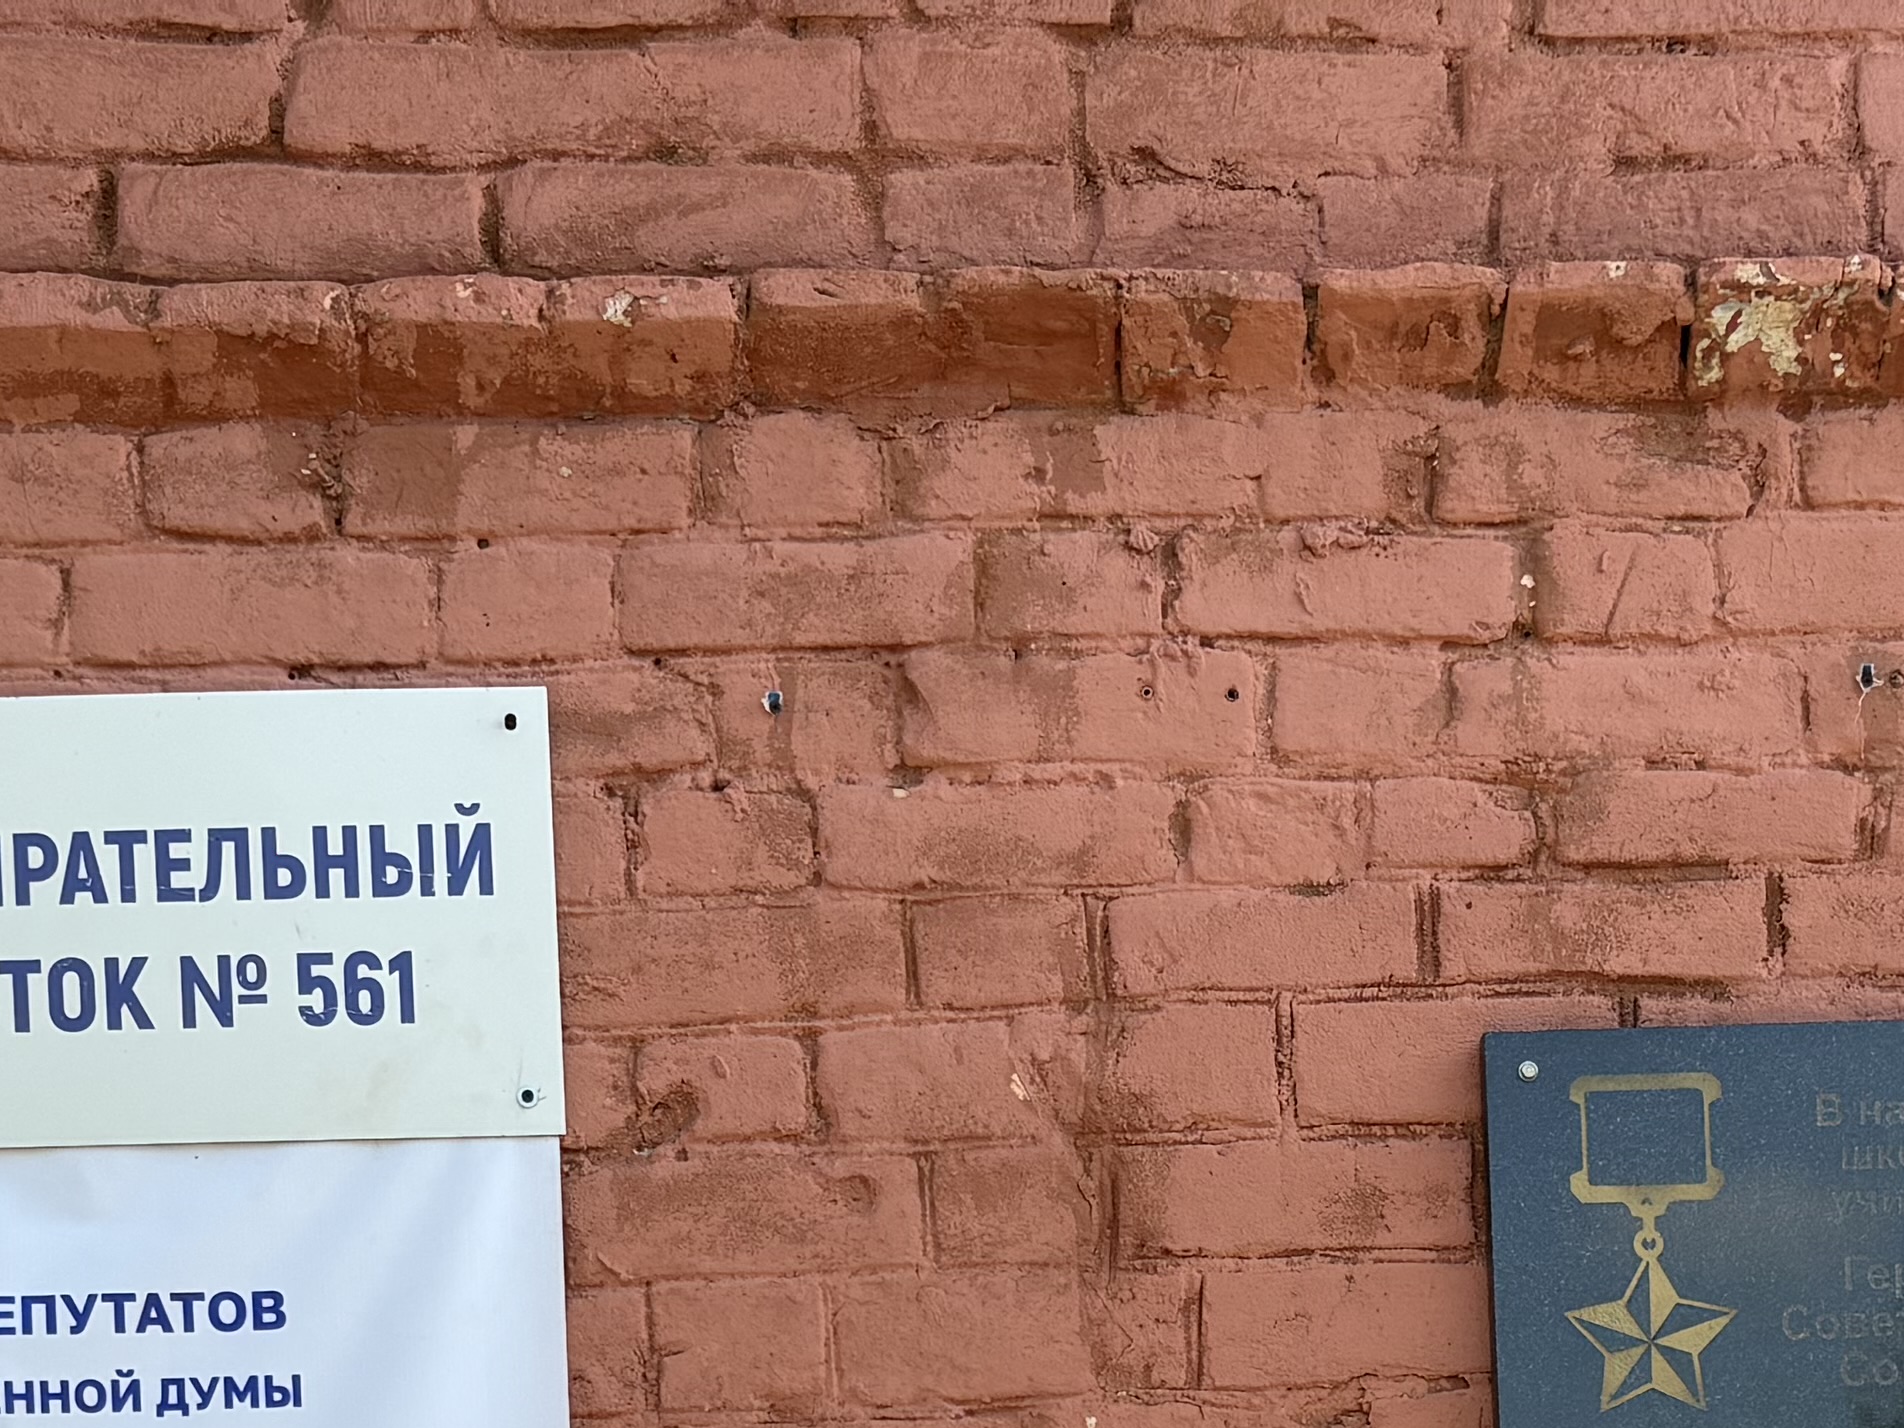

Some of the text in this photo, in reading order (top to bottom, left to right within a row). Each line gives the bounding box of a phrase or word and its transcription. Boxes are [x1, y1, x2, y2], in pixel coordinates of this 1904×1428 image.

[179, 953, 268, 1030] №
[296, 950, 416, 1027] 561
[1815, 1093, 1842, 1128] В
[156, 1374, 302, 1418] ДУМЫ
